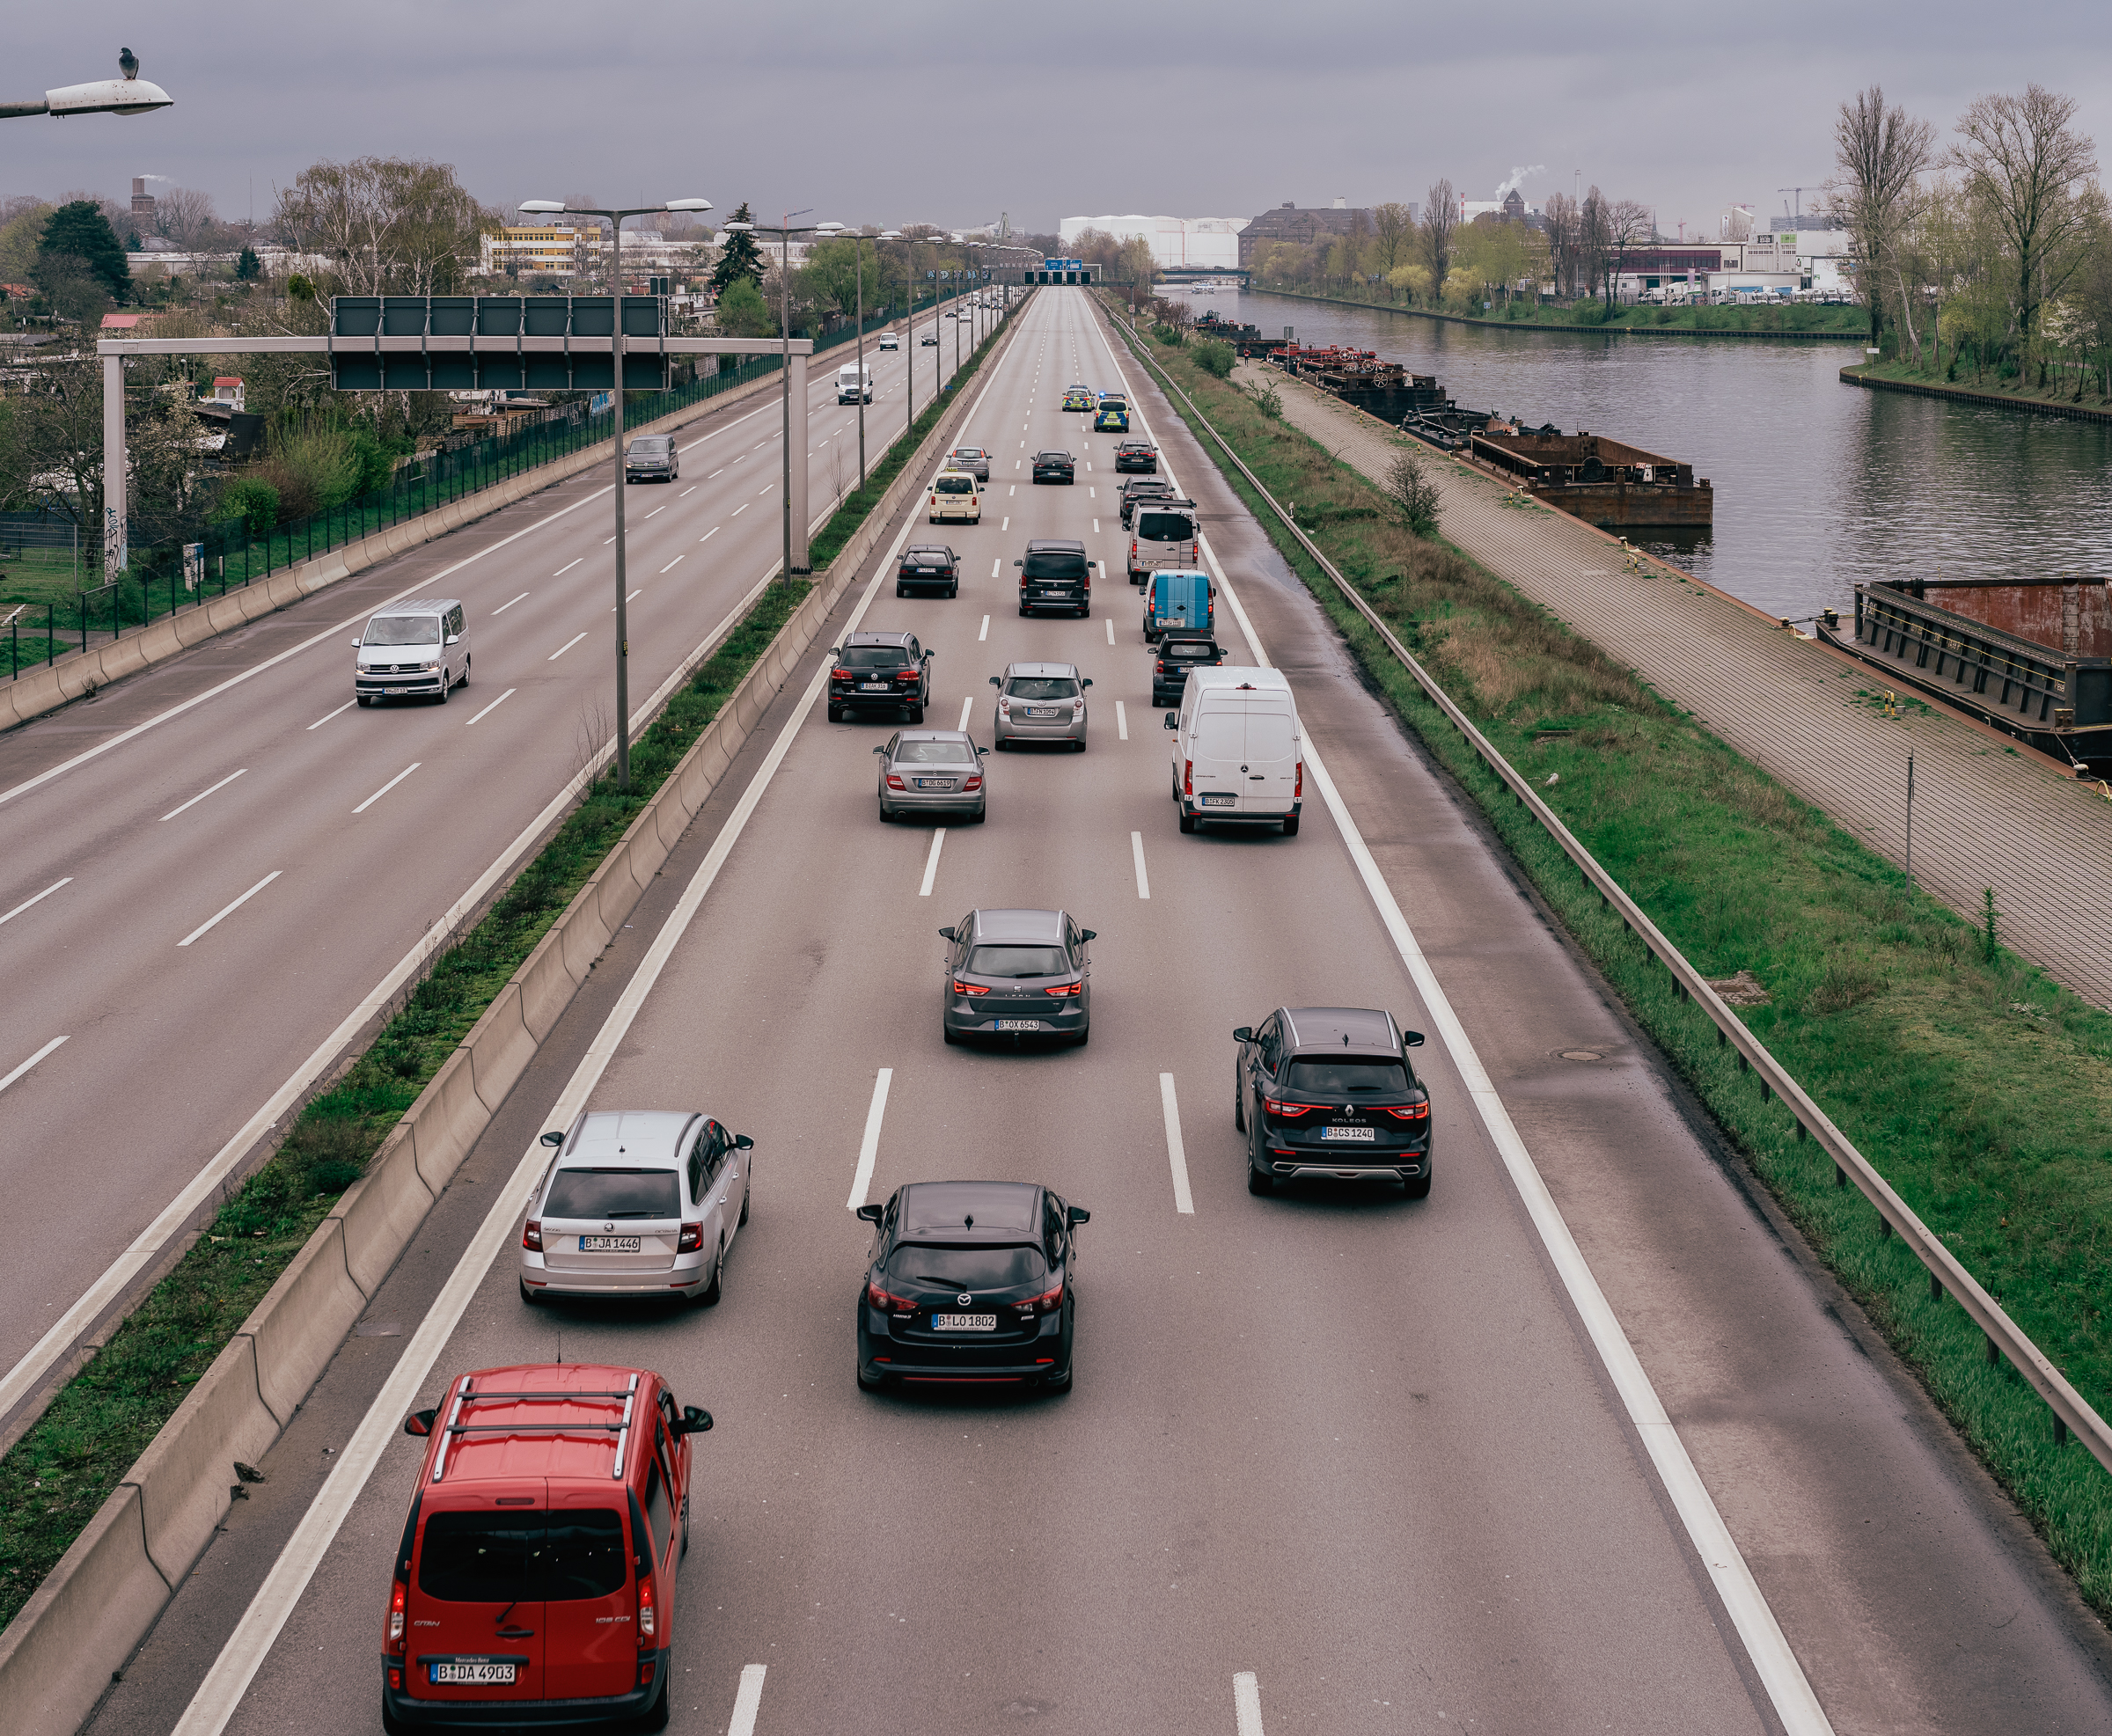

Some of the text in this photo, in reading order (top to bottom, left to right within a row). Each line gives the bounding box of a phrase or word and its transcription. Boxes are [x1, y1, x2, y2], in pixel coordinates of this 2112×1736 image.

[1327, 1127, 1373, 1138] B CS 1240
[585, 1238, 638, 1249] B JA 1446
[938, 1315, 994, 1327] B LO 1802
[439, 1666, 513, 1680] B DA 4903
